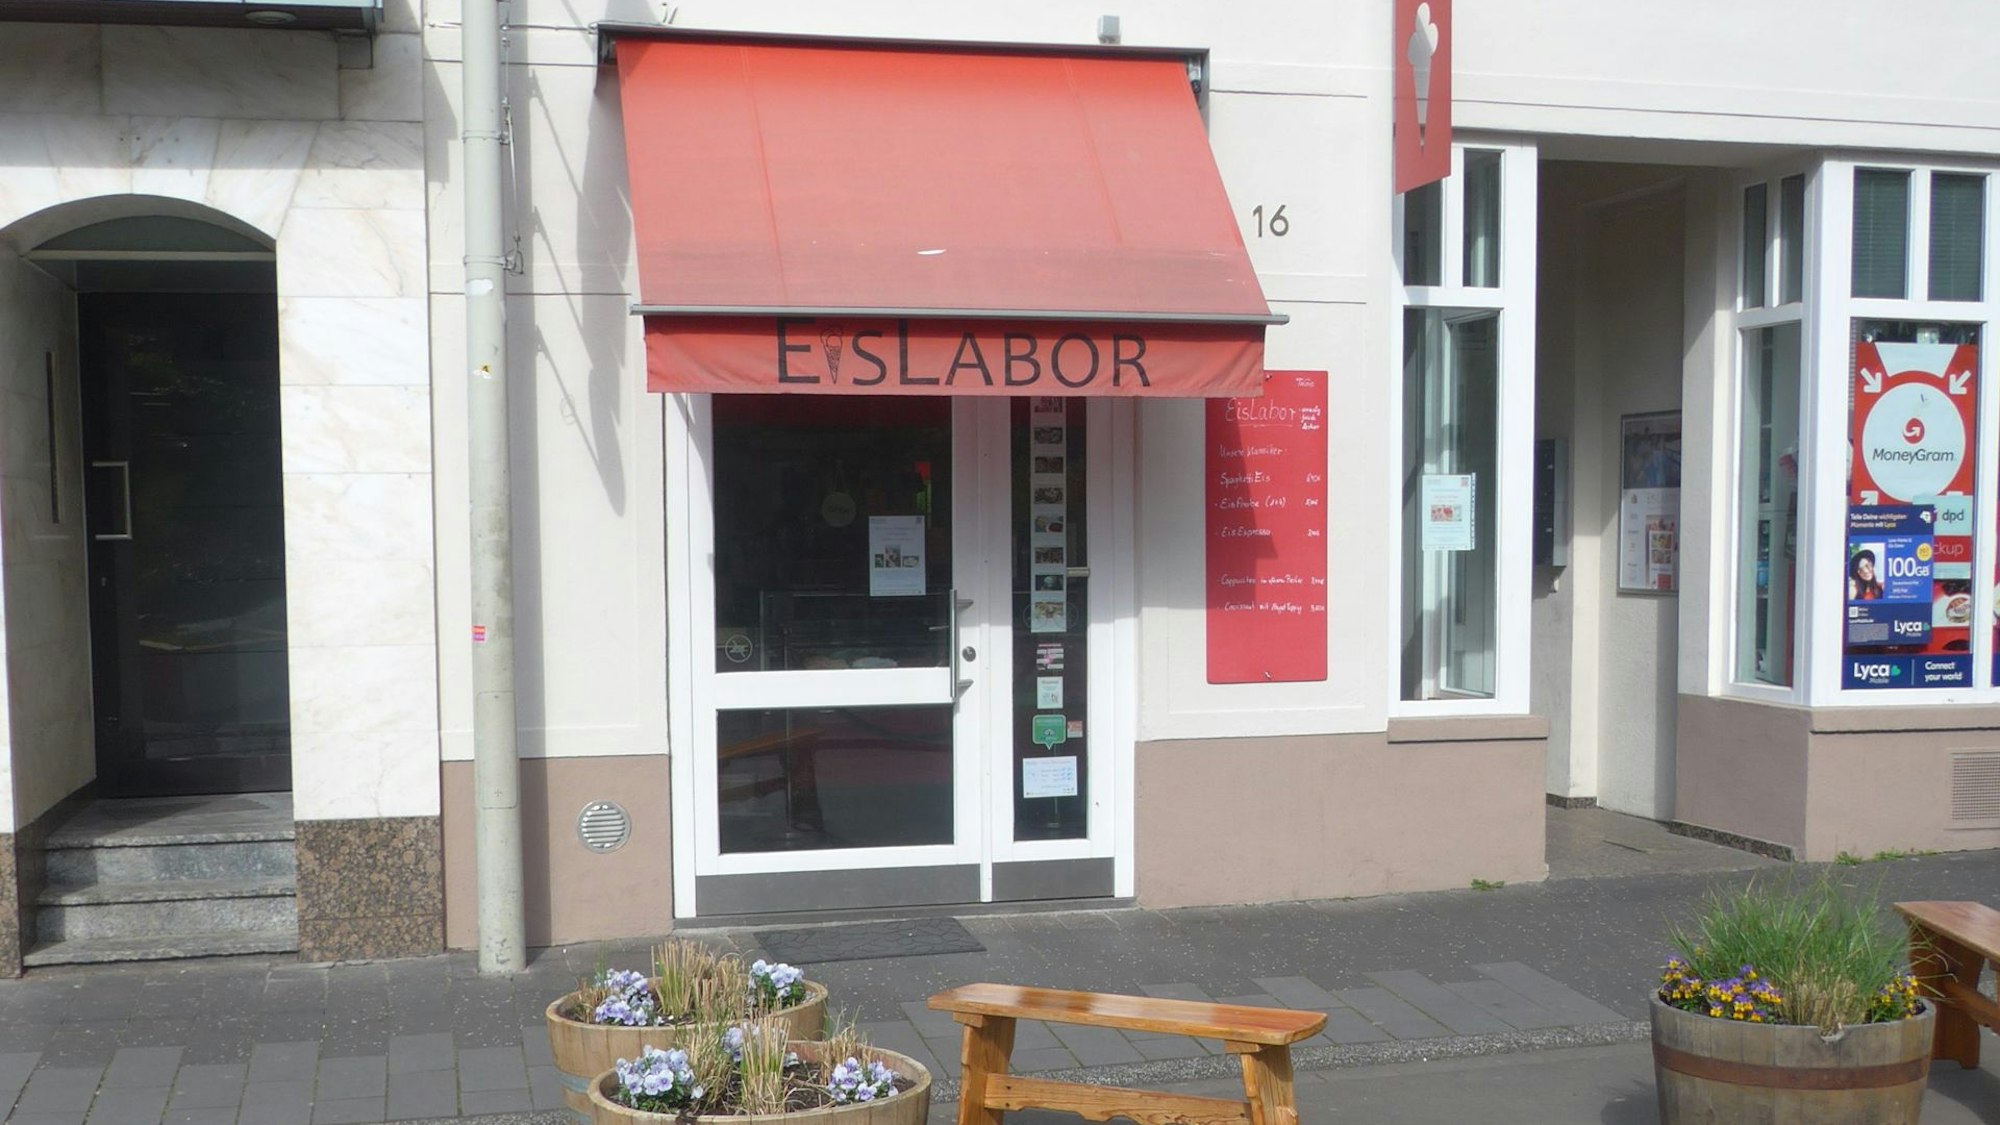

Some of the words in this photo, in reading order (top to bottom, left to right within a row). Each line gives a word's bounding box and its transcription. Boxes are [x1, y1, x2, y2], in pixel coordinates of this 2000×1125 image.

[1252, 204, 1289, 238] 16
[1872, 448, 1954, 464] MoneyGram
[1942, 509, 1965, 523] dpd
[1933, 541, 1964, 557] ckup
[1894, 620, 1923, 635] Lyca
[1854, 662, 1891, 681] Lyca
[1925, 661, 1956, 670] Connect
[1925, 673, 1941, 683] your
